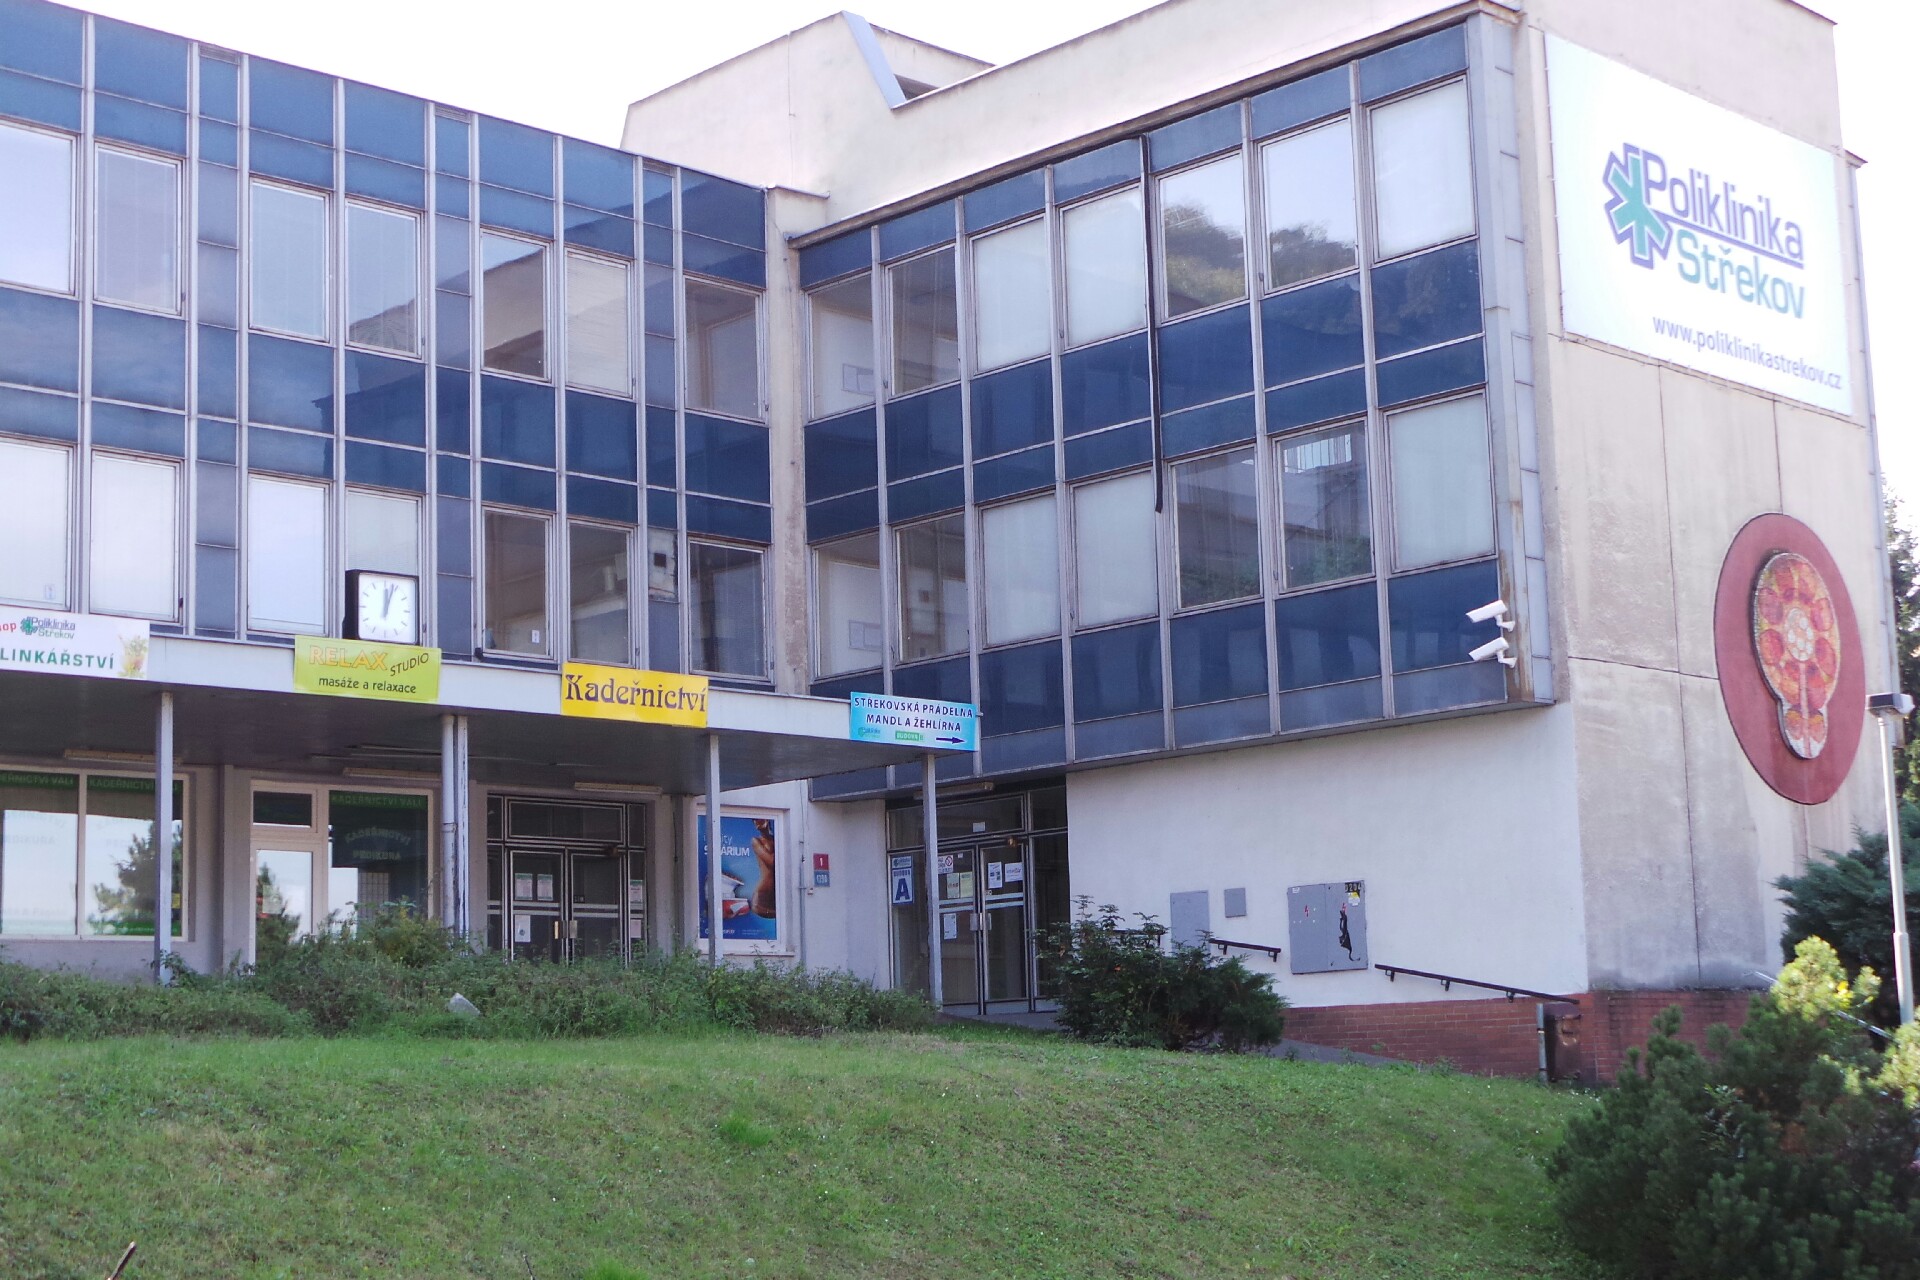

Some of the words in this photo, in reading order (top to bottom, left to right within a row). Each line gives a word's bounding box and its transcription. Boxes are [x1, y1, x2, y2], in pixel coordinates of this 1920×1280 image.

[1642, 150, 1804, 261] Poliklinika
[1677, 229, 1804, 319] Střekov
[1653, 316, 1842, 390] www.poliklinikastrekov.cz
[0, 622, 17, 633] op
[31, 616, 76, 631] Poliklinika
[38, 628, 75, 640] Střekov
[309, 645, 388, 671] RELAX
[390, 652, 430, 677] STUDIO
[319, 676, 359, 689] masáže
[363, 681, 369, 690] a
[372, 680, 416, 693] relaxace
[565, 674, 706, 712] Kadeřnictví
[854, 697, 920, 713] STŘEKOVSKÁ
[922, 704, 973, 718] PRÁDELNA
[866, 714, 904, 726] MANDL
[905, 718, 911, 727] A
[913, 717, 961, 732] ŽEHLÍRNA
[896, 878, 910, 900] A
